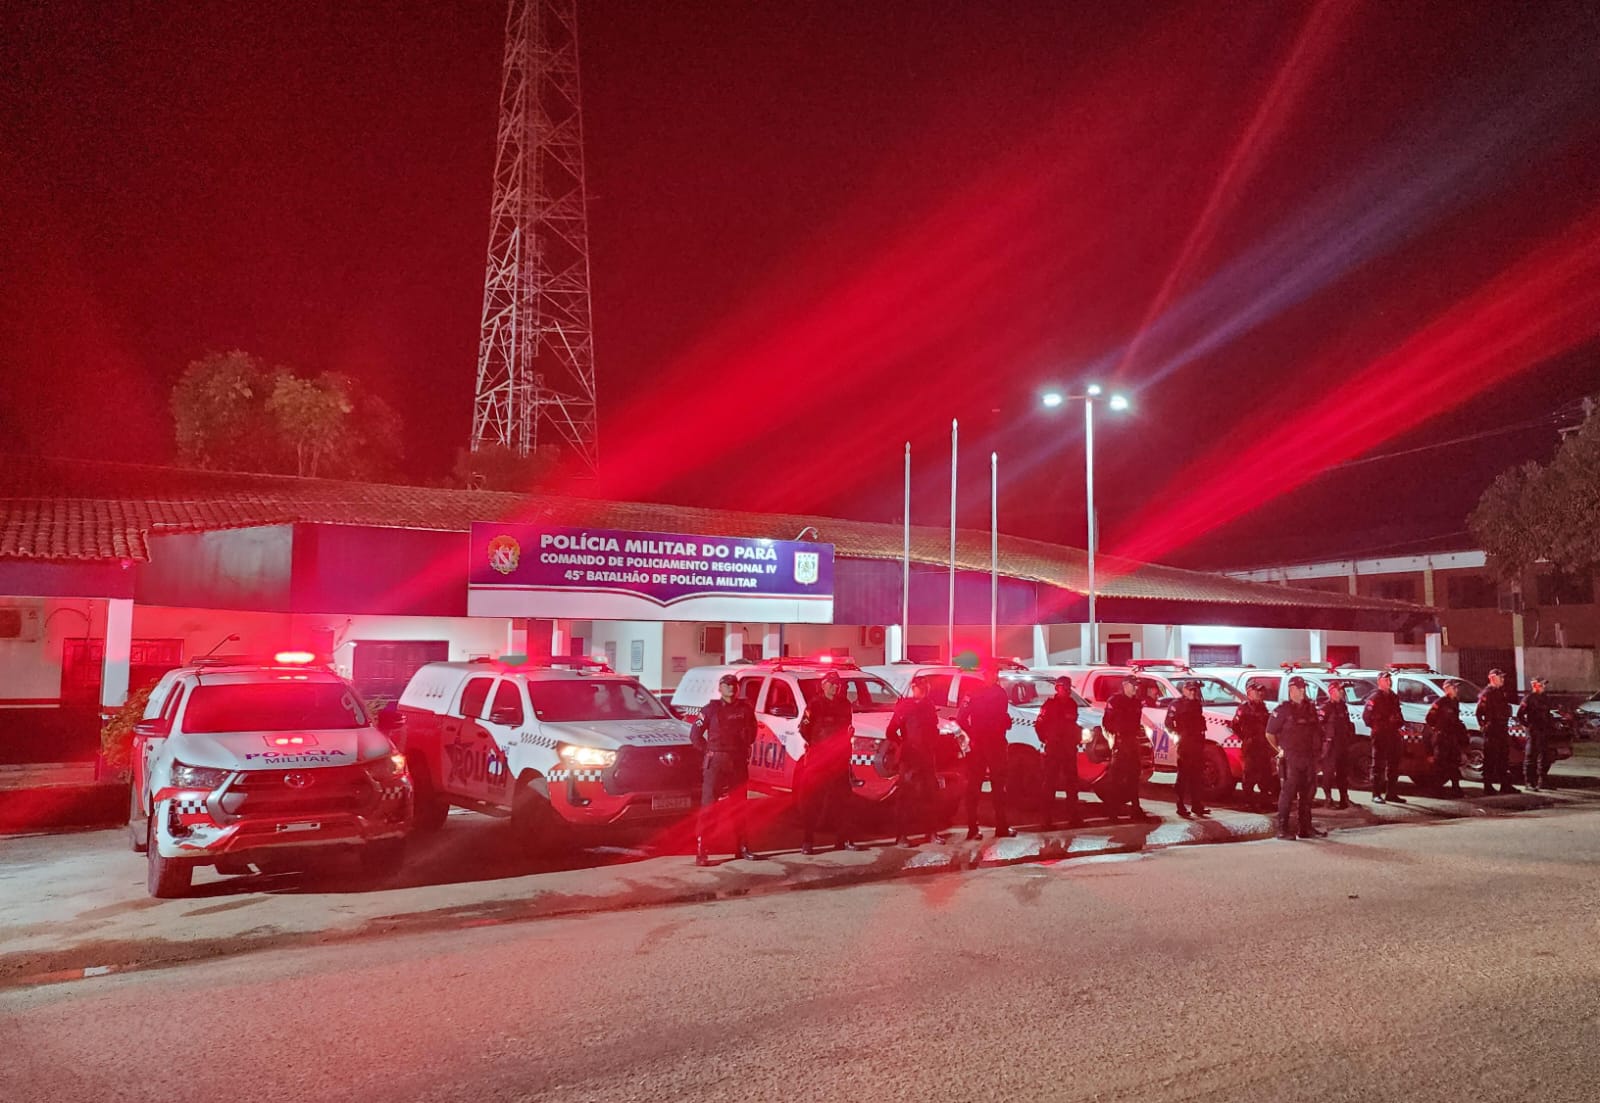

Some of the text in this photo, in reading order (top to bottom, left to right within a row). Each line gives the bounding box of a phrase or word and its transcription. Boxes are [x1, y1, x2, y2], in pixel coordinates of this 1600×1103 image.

[540, 532, 778, 561] POLÍCIA MILITAR DO PARÁ
[540, 553, 778, 574] COMANDO DE POLICIAMENTO REGIONAL IV
[586, 570, 650, 584] BATALHÃO
[652, 573, 667, 584] DE
[670, 573, 714, 587] POLÍCIA
[716, 576, 758, 588] MILITAR
[265, 756, 331, 765] MILITAR
